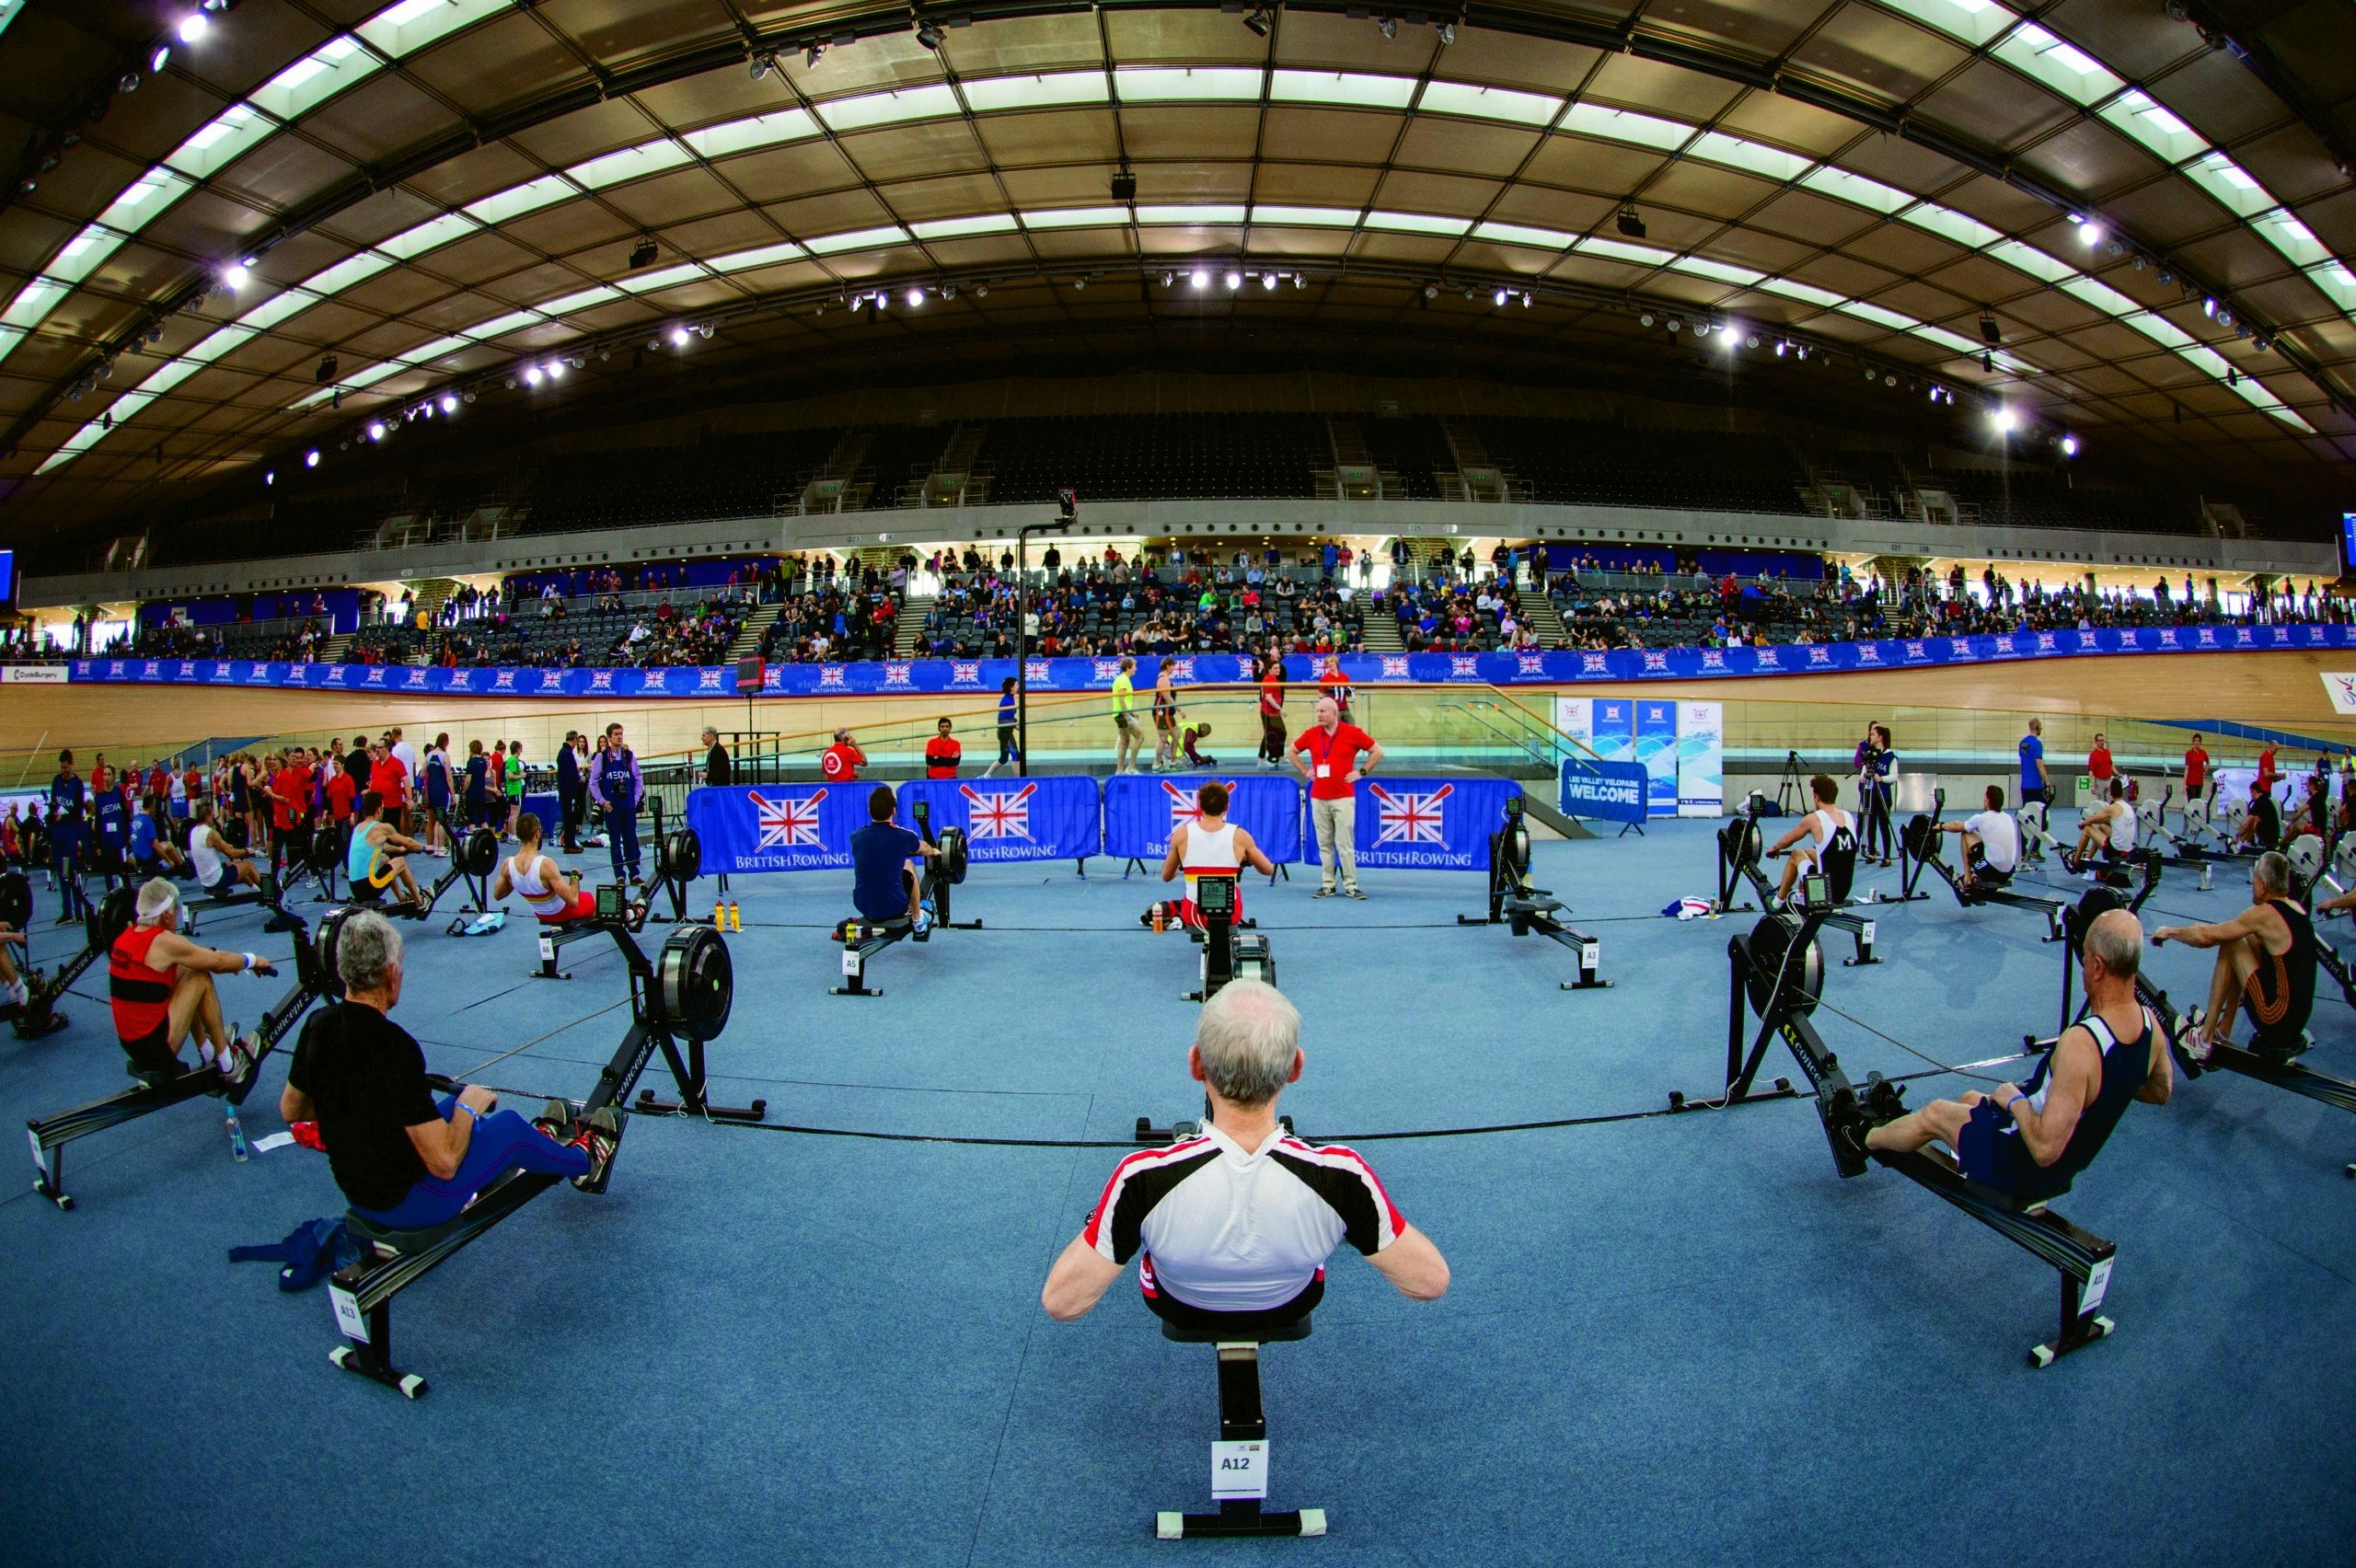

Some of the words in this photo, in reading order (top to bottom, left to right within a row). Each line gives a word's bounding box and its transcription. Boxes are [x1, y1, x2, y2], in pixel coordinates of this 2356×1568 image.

[1580, 777, 1604, 785] VALLEY
[1604, 778, 1639, 789] VELOPARK
[1569, 784, 1639, 805] WELCOME
[1836, 835, 1852, 851] M
[269, 998, 305, 1043] concept
[1795, 1042, 1821, 1083] conce
[616, 1045, 649, 1103] concept
[2093, 1274, 2105, 1286] A11
[341, 1305, 355, 1319] A13
[1221, 1458, 1250, 1470] A12
